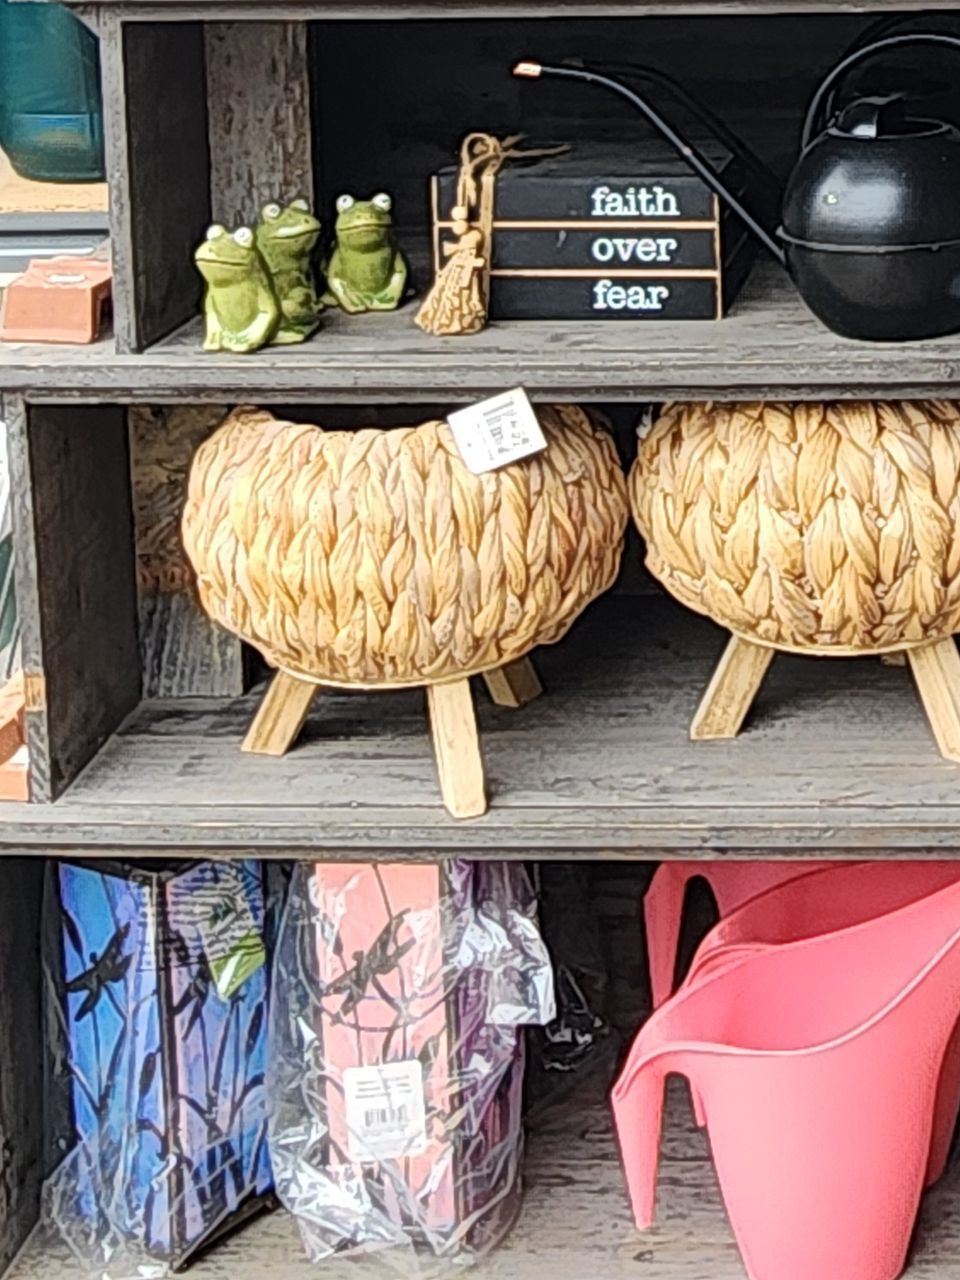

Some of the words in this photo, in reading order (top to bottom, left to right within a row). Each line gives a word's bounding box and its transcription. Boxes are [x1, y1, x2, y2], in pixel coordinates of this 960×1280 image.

[591, 186, 680, 216] faith
[591, 237, 677, 261] over
[593, 280, 669, 309] fear
